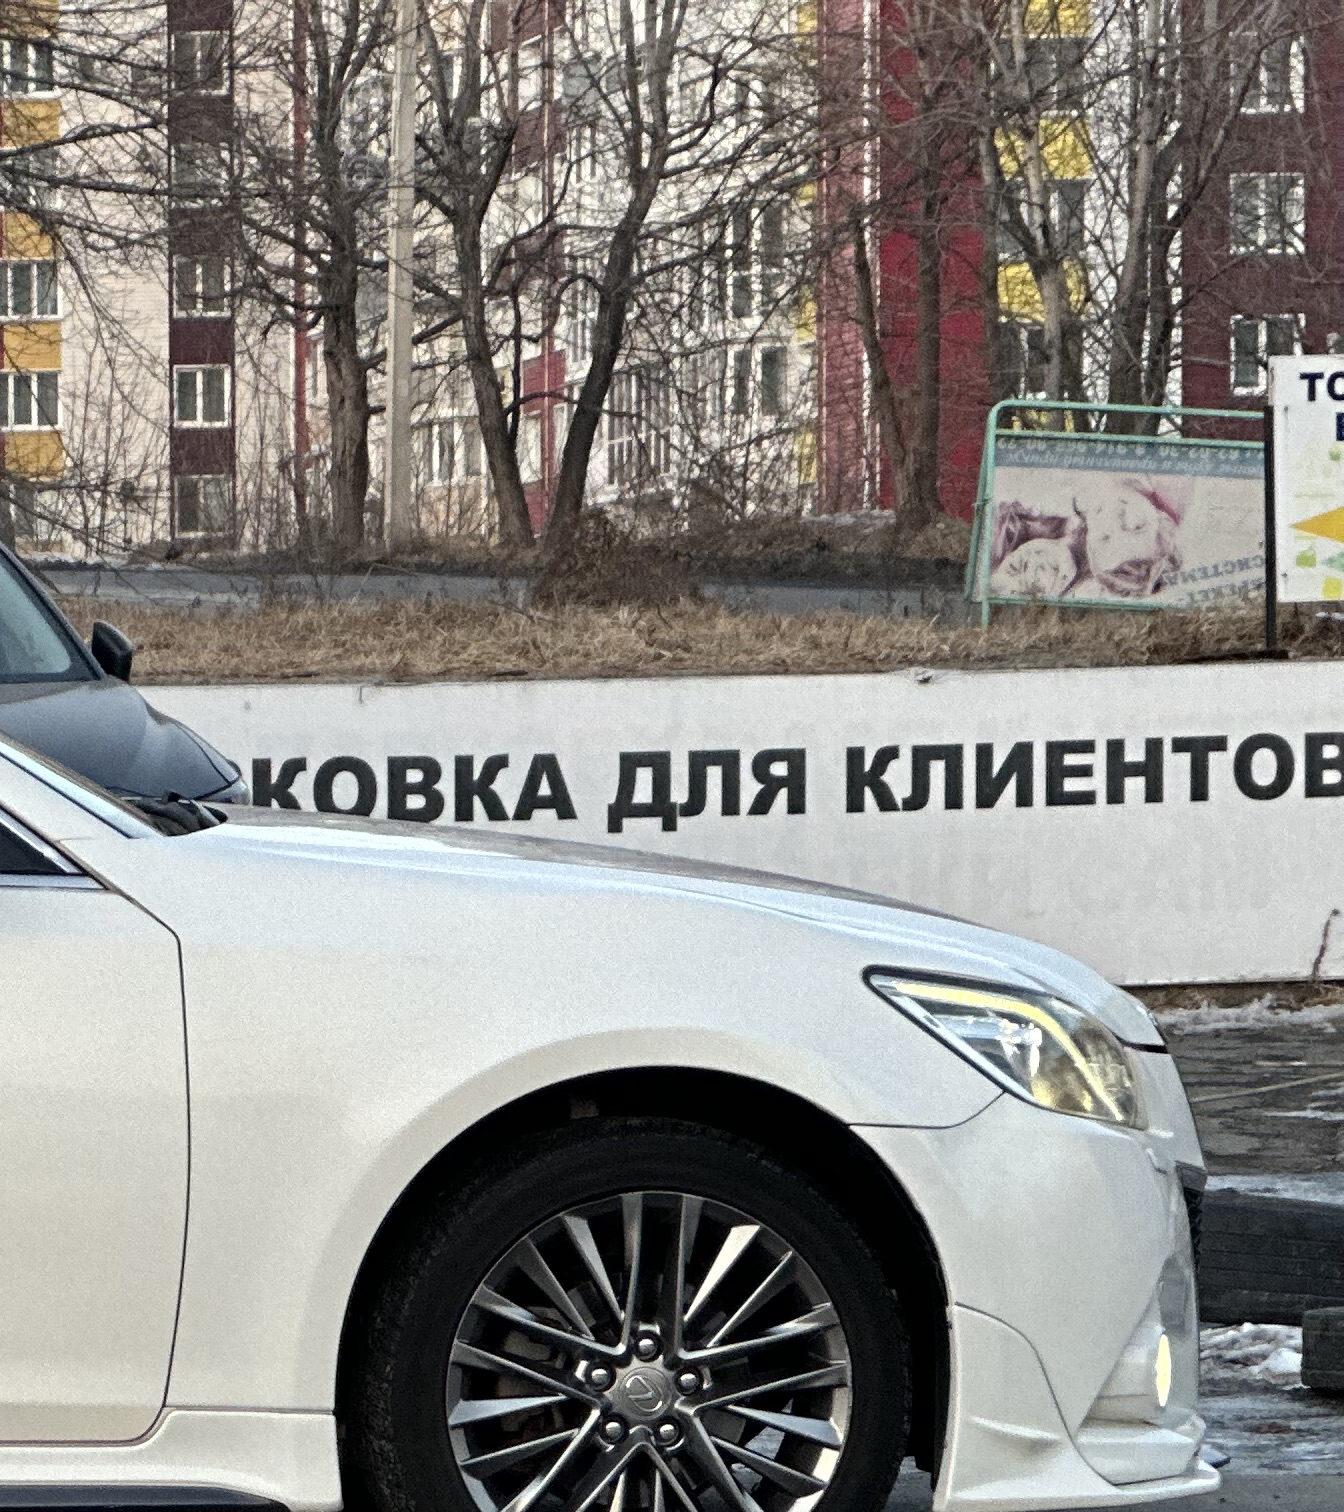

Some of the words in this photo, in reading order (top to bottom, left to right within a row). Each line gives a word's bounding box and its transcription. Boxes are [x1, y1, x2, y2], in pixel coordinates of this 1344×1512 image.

[227, 753, 578, 823] КОВКА
[607, 748, 806, 833] ДЛЯ
[846, 732, 1344, 813] КЛИЕНТОВ
